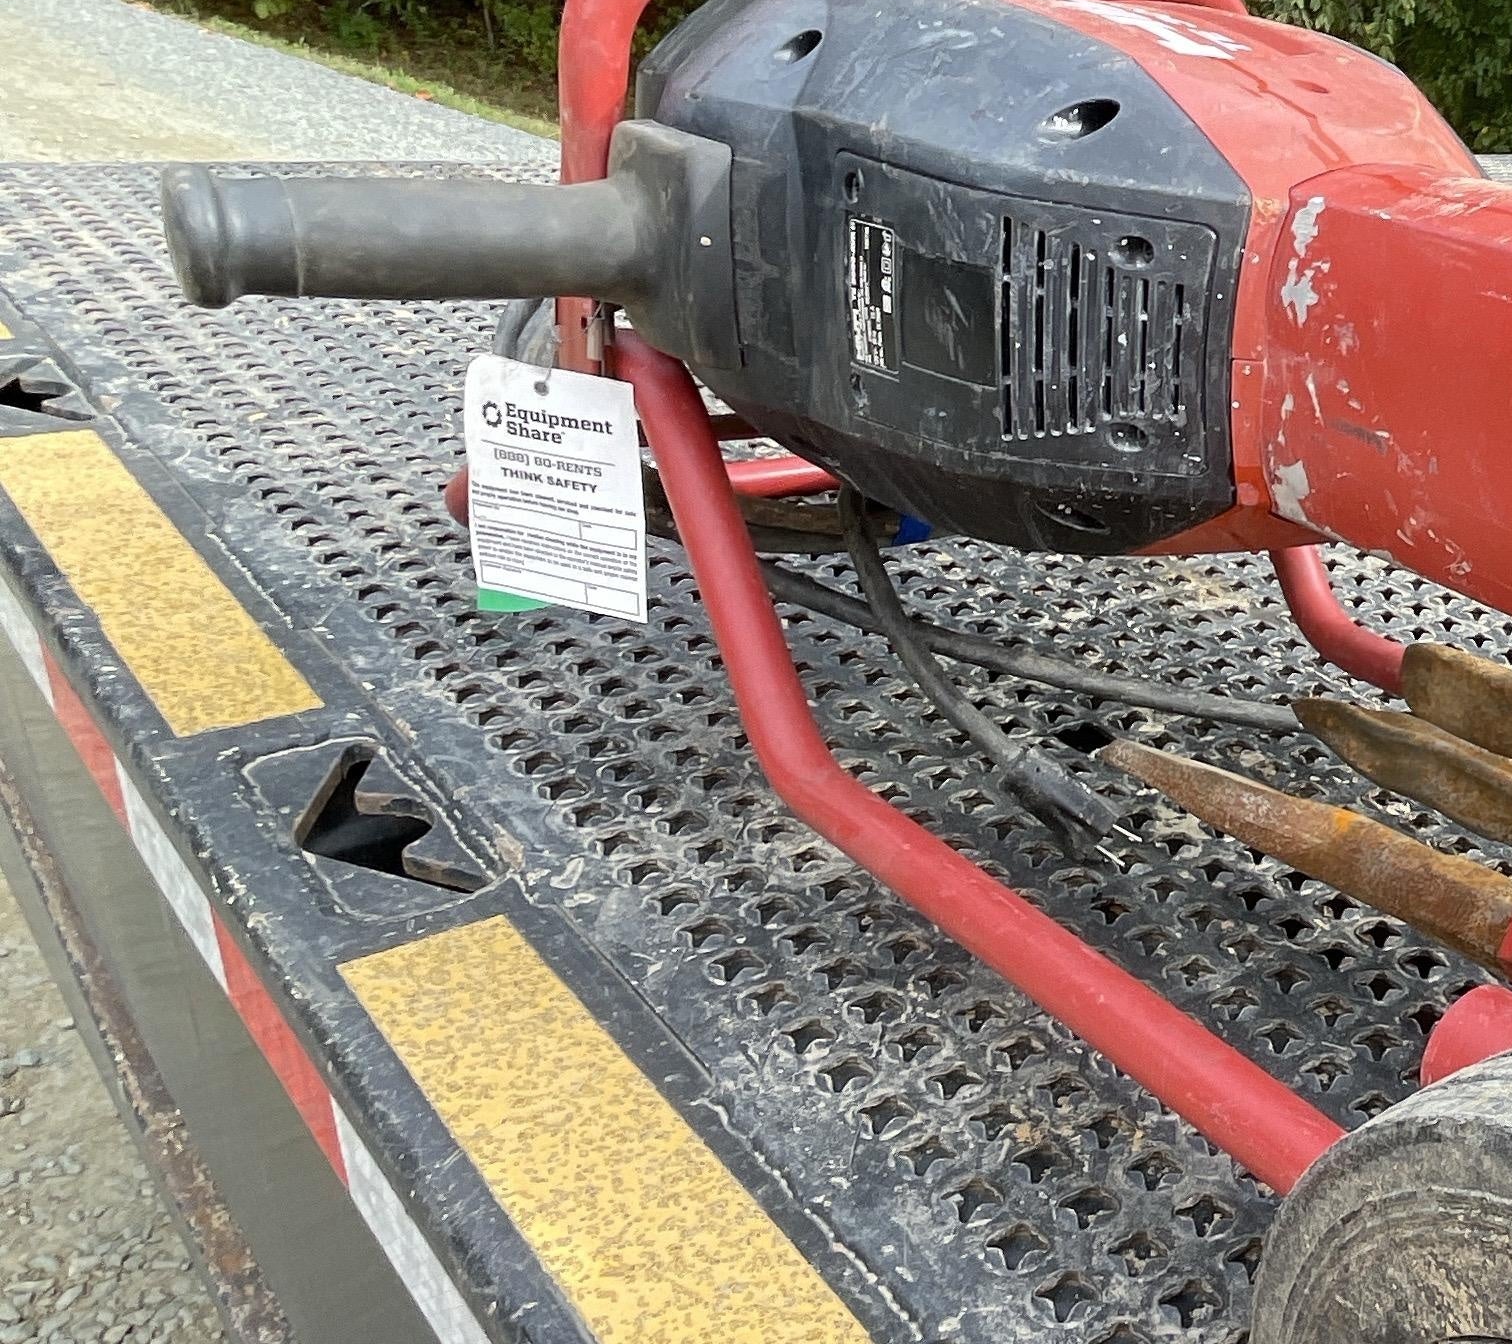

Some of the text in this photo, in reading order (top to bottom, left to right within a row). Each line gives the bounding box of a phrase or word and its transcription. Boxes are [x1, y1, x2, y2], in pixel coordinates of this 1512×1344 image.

[504, 401, 613, 435] Equipment
[505, 420, 563, 444] Share
[500, 466, 598, 494] THINK SAFETY
